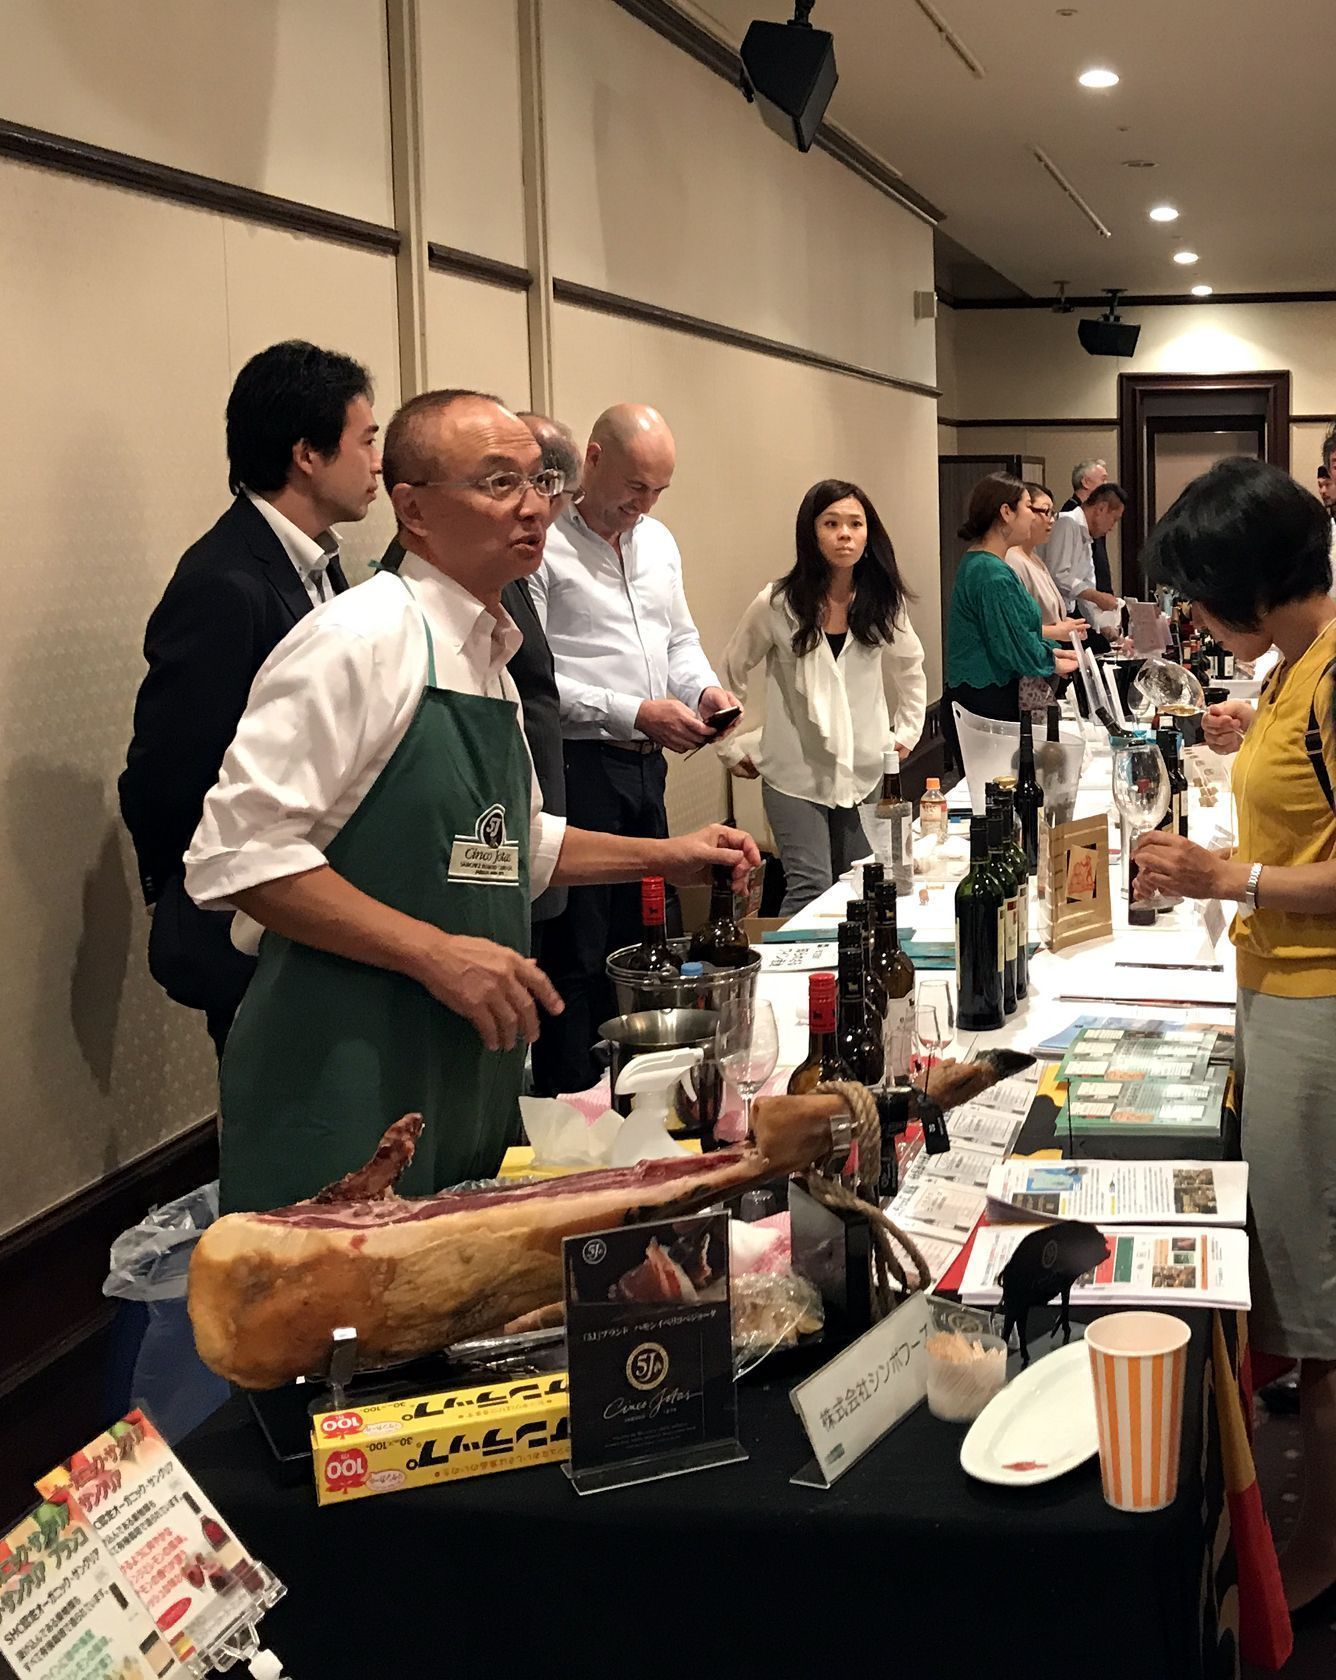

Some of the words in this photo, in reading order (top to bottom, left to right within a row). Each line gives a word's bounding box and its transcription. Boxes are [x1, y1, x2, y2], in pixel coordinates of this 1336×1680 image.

[603, 1397, 648, 1420] Cinco
[322, 1416, 360, 1432] 100
[326, 1457, 364, 1479] 100
